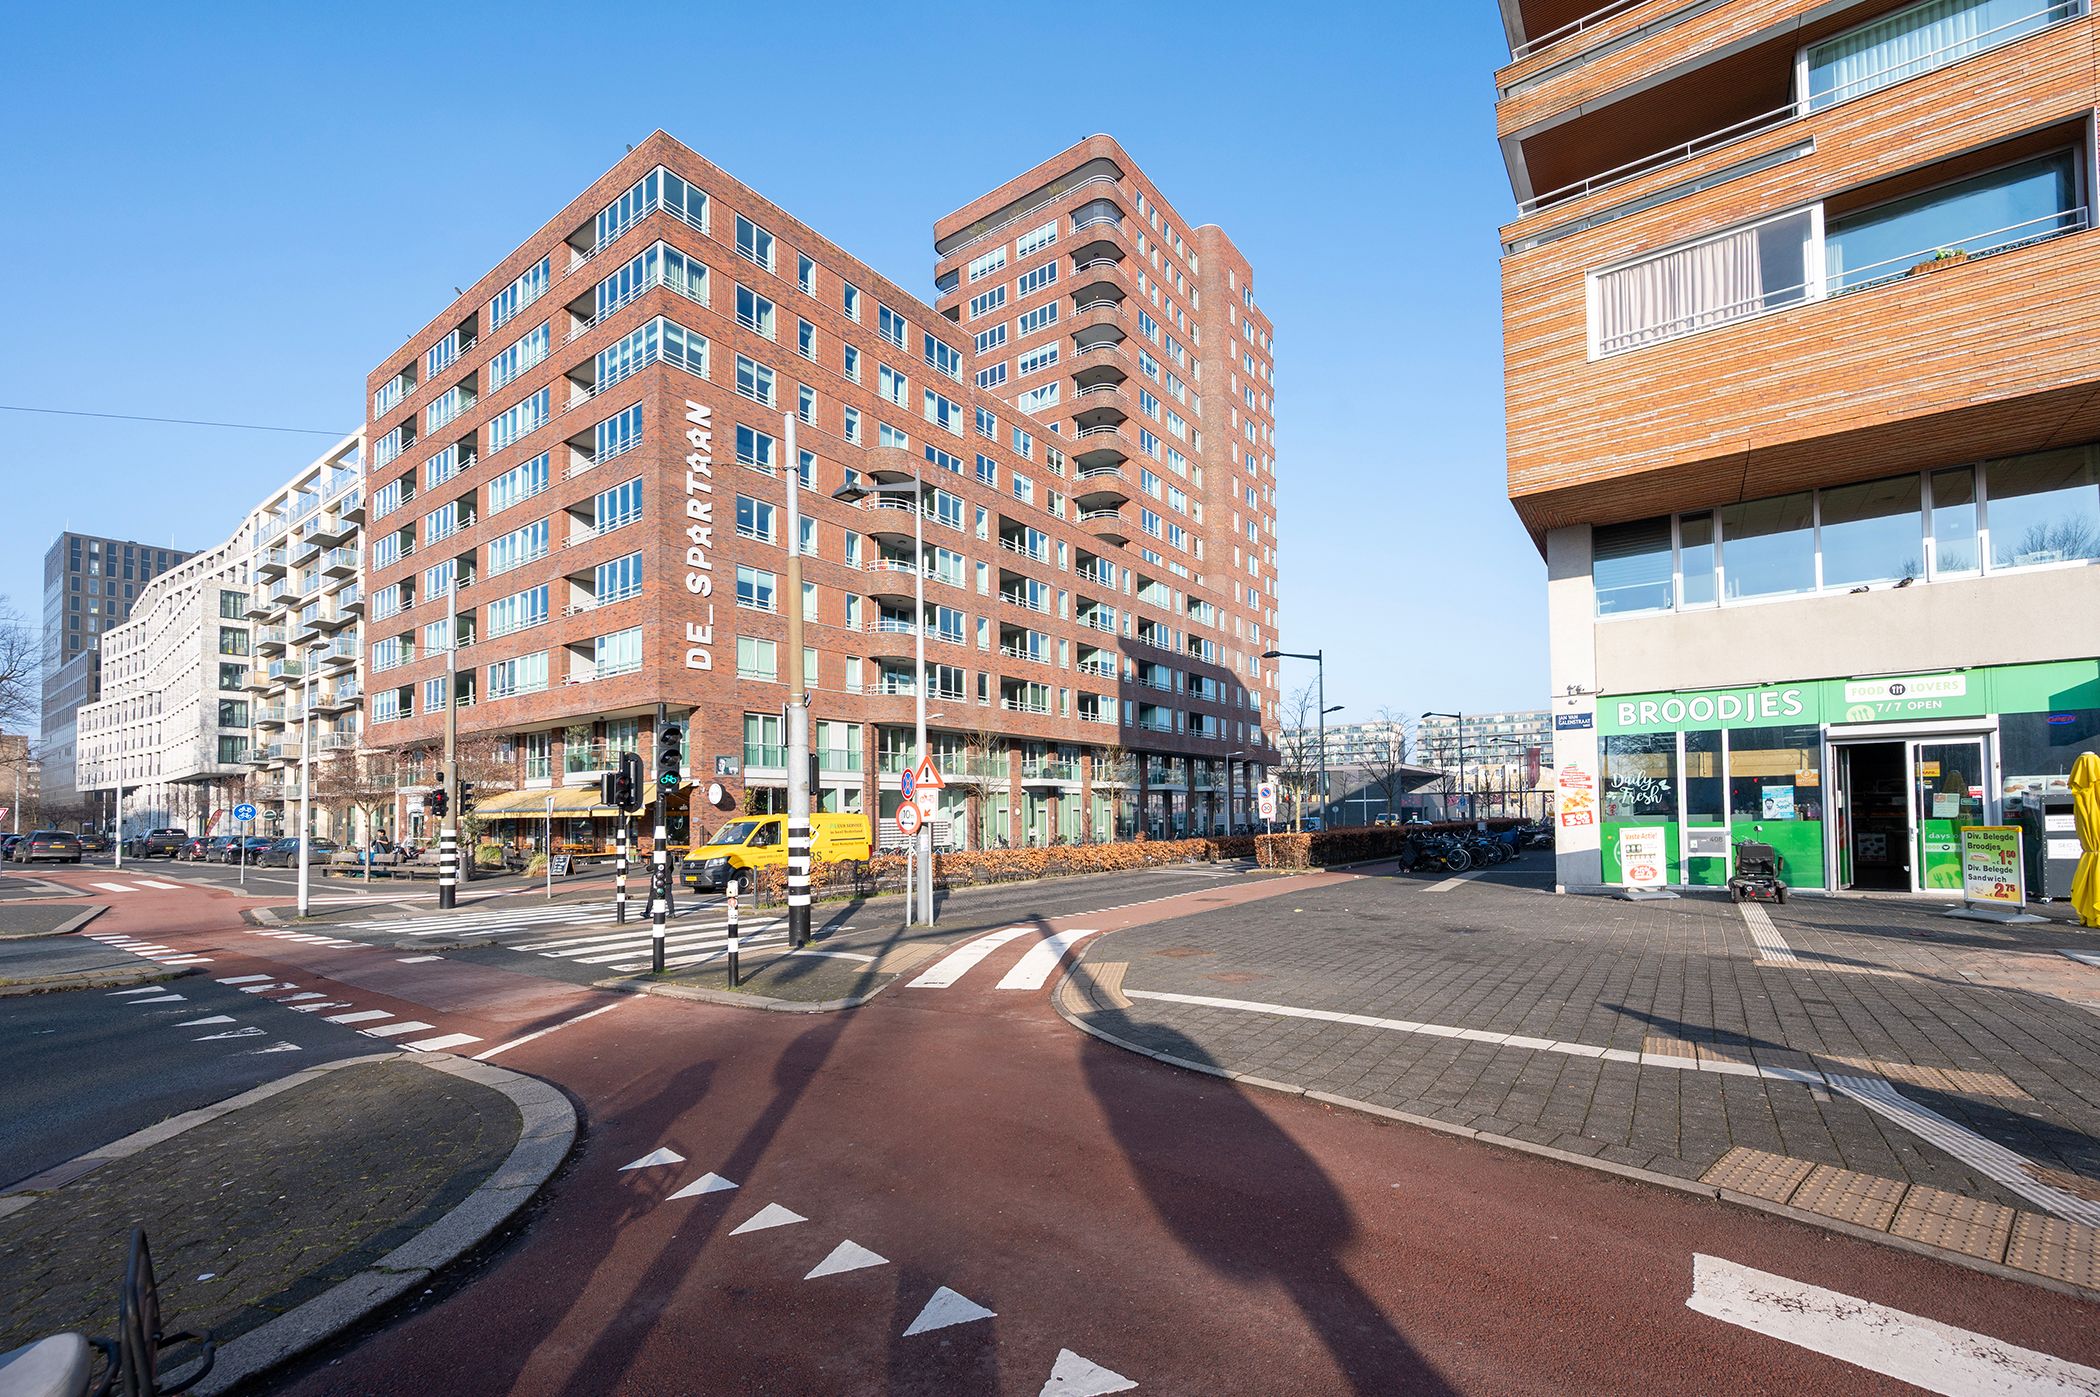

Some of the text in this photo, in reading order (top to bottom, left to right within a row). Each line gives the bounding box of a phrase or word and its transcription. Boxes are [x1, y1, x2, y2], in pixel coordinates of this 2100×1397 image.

[1852, 680, 1959, 696] FOOD LOVERS
[1617, 689, 1804, 727] BROODJES
[1907, 700, 1943, 710] OPEN
[1559, 718, 1591, 726] GALENSTRAAT
[1610, 769, 1656, 791] Daily
[1620, 785, 1663, 805] Fresh
[1928, 832, 1951, 841] days
[1983, 833, 2014, 841] Belegde
[1967, 842, 2001, 851] Broodjes
[1983, 865, 2014, 874] Belegde
[1968, 874, 2007, 883] Sandwich
